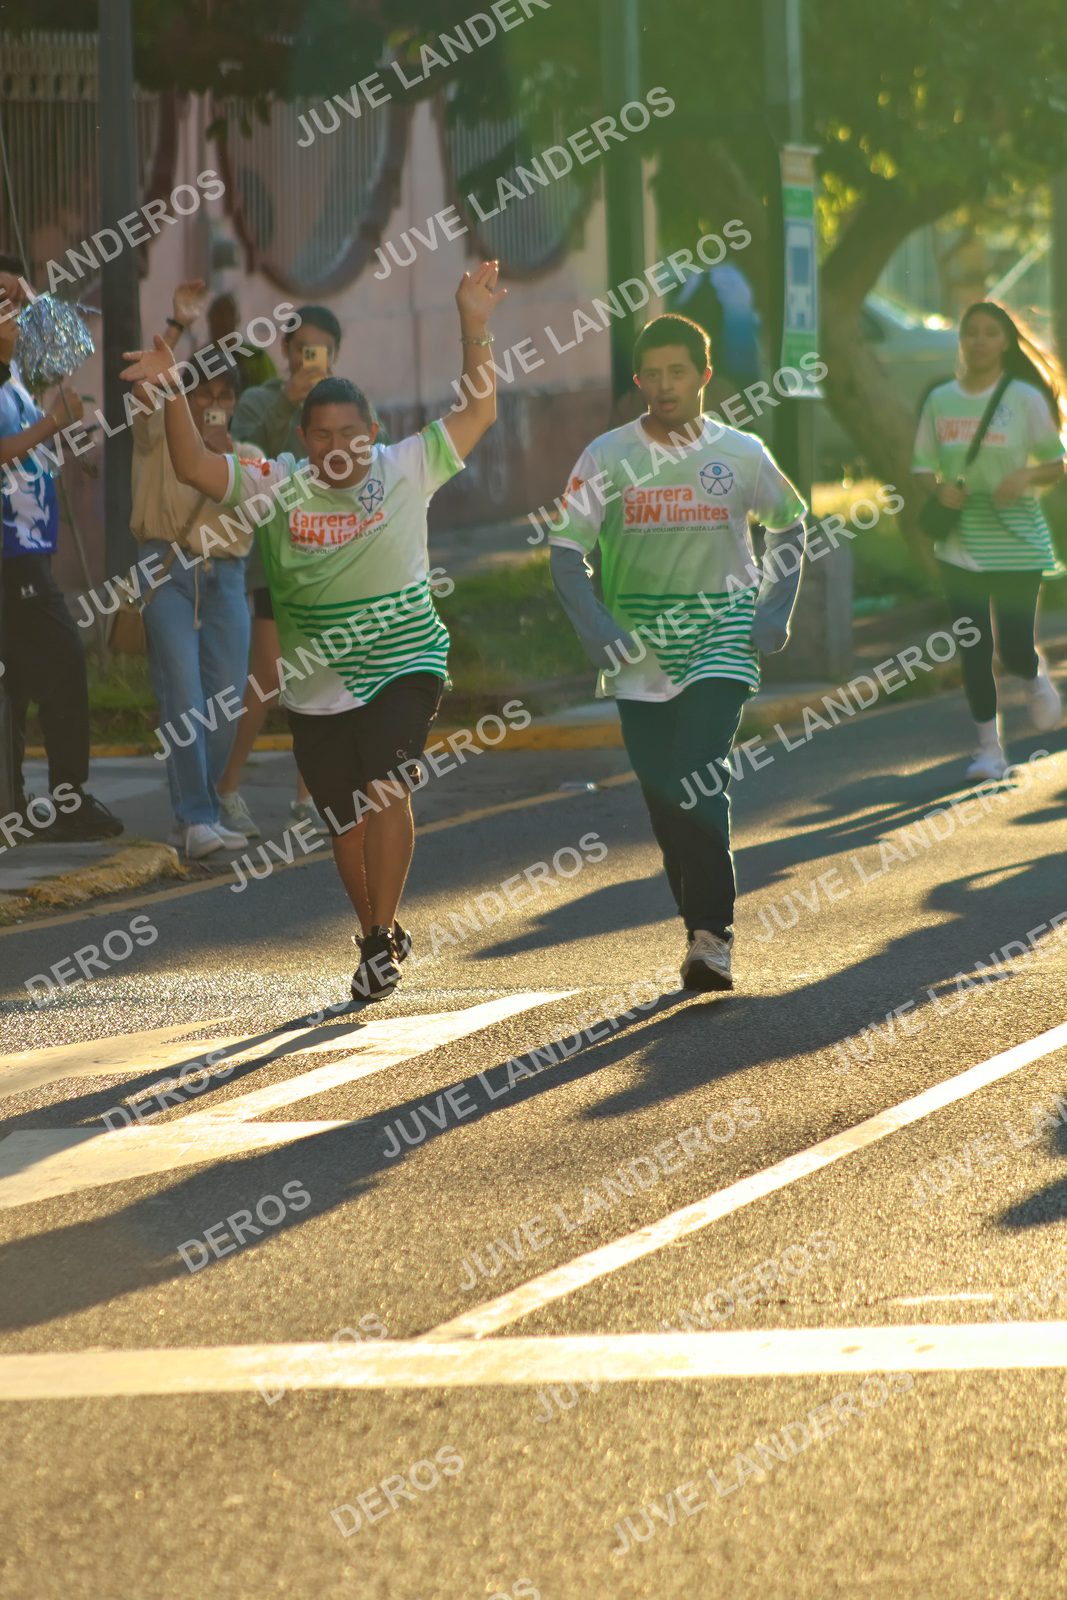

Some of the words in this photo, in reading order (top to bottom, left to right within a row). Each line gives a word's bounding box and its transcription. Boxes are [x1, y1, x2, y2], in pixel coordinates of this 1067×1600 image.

[624, 486, 693, 504] Carrera
[292, 507, 357, 528] Carrera
[624, 504, 662, 525] SIN
[666, 503, 729, 522] límites
